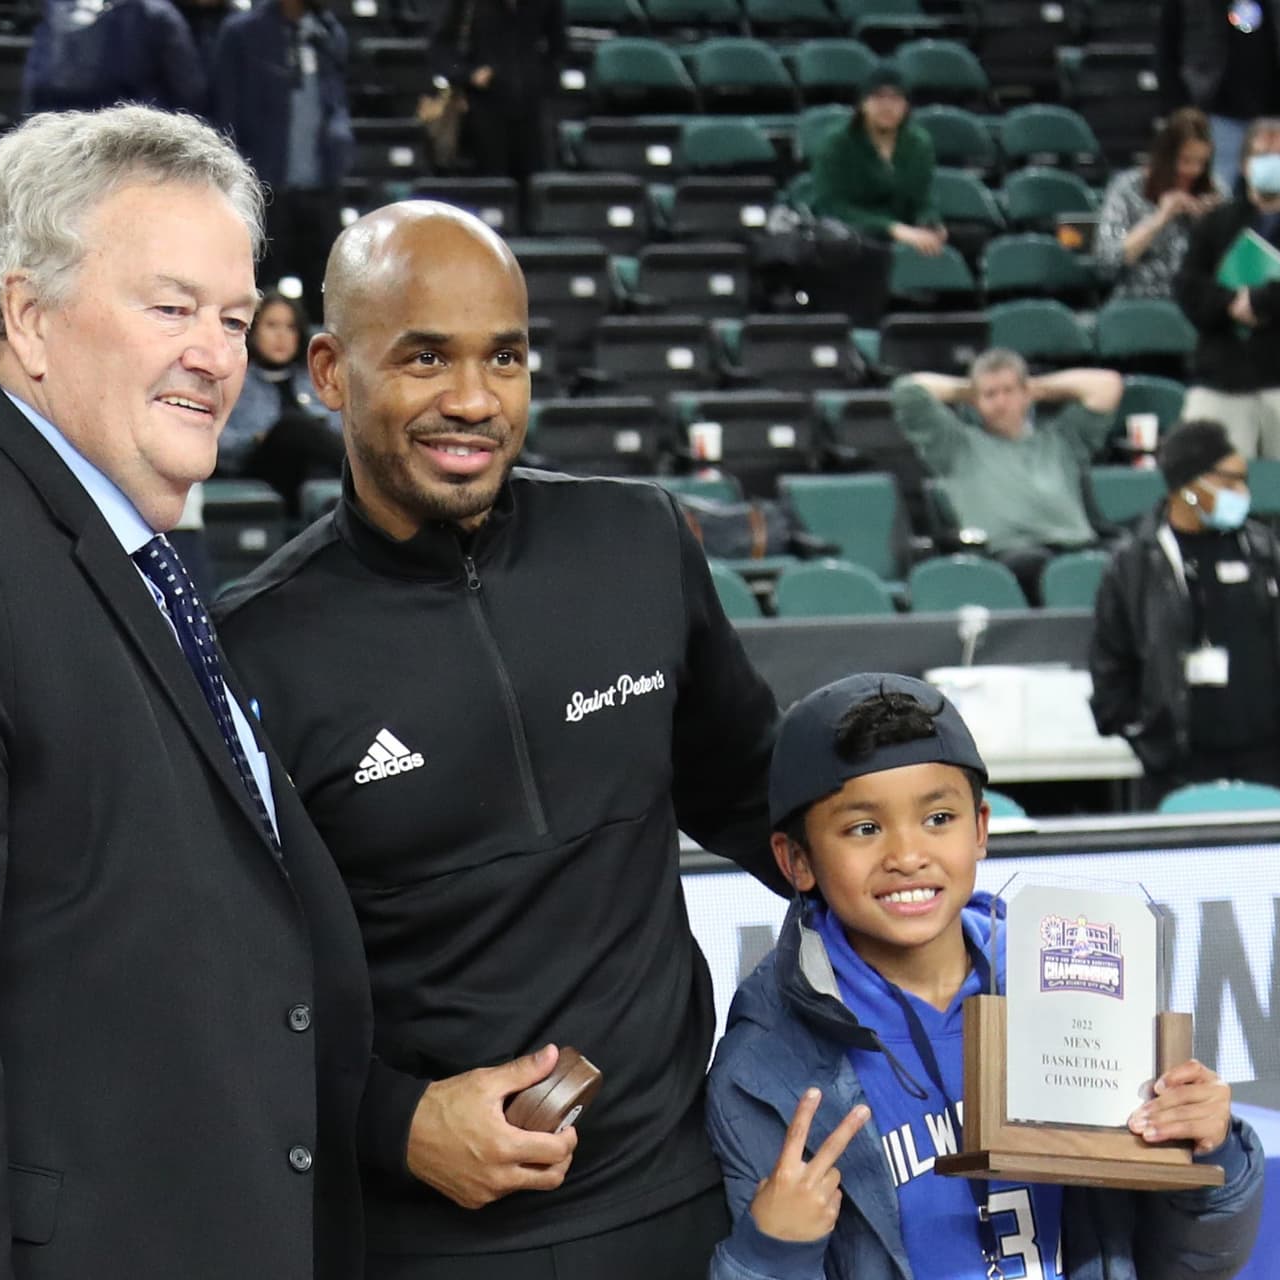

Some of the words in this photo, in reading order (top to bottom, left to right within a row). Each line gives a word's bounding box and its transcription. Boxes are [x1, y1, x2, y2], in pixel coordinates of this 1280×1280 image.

[565, 685, 616, 722] Saint
[617, 670, 665, 705] Peter's
[354, 752, 425, 784] adidas
[1071, 1018, 1094, 1031] 2022
[1063, 1035, 1102, 1049] MEN'S
[1042, 1053, 1122, 1072] BASKETBALL
[1044, 1073, 1119, 1090] CHAMPIONS
[882, 1101, 964, 1188] ILW
